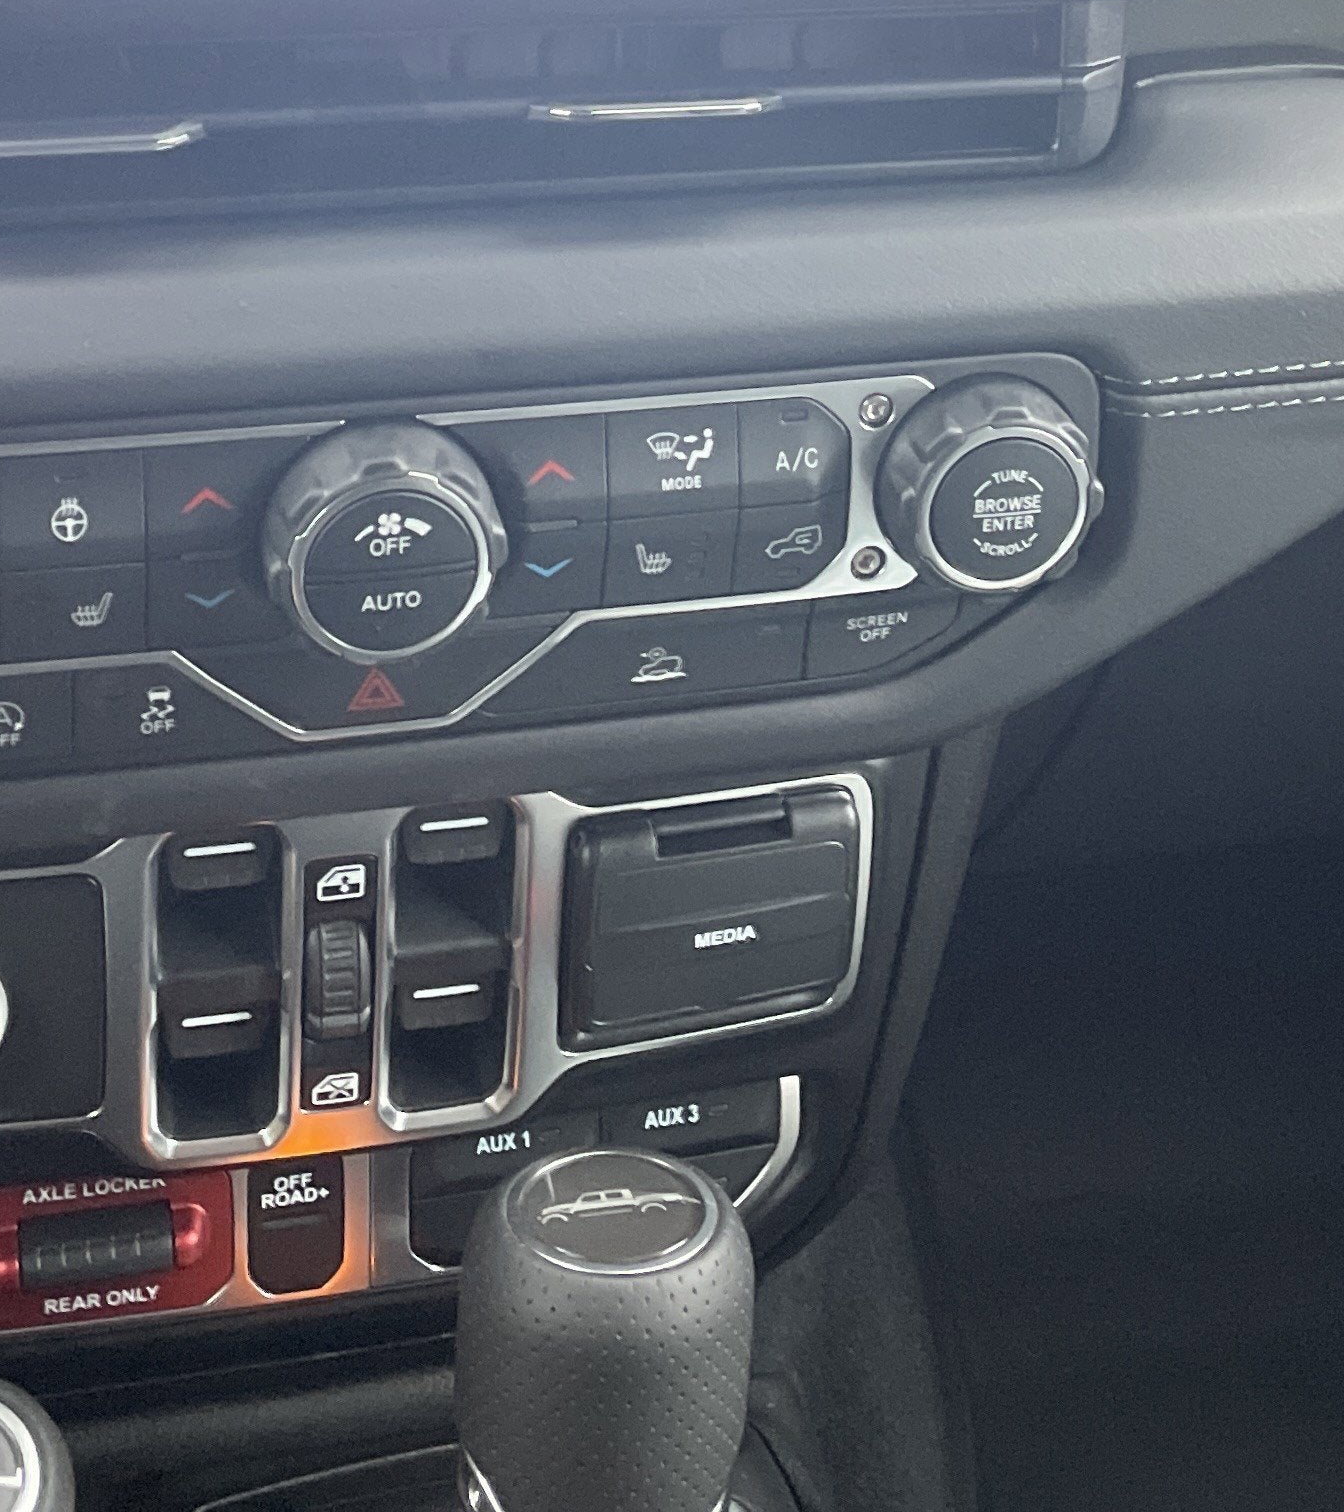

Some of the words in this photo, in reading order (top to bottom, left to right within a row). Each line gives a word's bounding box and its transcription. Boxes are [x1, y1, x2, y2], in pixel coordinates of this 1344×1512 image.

[775, 447, 819, 473] A/C
[661, 475, 702, 492] MODE
[991, 470, 1028, 485] TUNE
[975, 494, 1042, 513] BROWSE
[982, 515, 1034, 533] ENTER
[369, 536, 412, 558] OFF
[980, 539, 1033, 557] SCROLL
[360, 590, 422, 613] AUTO
[846, 611, 908, 632] SCREEN
[860, 626, 891, 643] OFF
[140, 717, 176, 735] OFF
[694, 925, 756, 949] MEDIA
[643, 1108, 685, 1131] AUX
[689, 1104, 700, 1125] 3
[476, 1134, 518, 1155] AUX
[522, 1131, 532, 1150] 1
[22, 1182, 77, 1205] AXLE
[273, 1173, 313, 1193] OFF
[261, 1184, 330, 1209] ROAD+
[43, 1292, 102, 1315] REAR
[105, 1284, 161, 1307] ONLY
